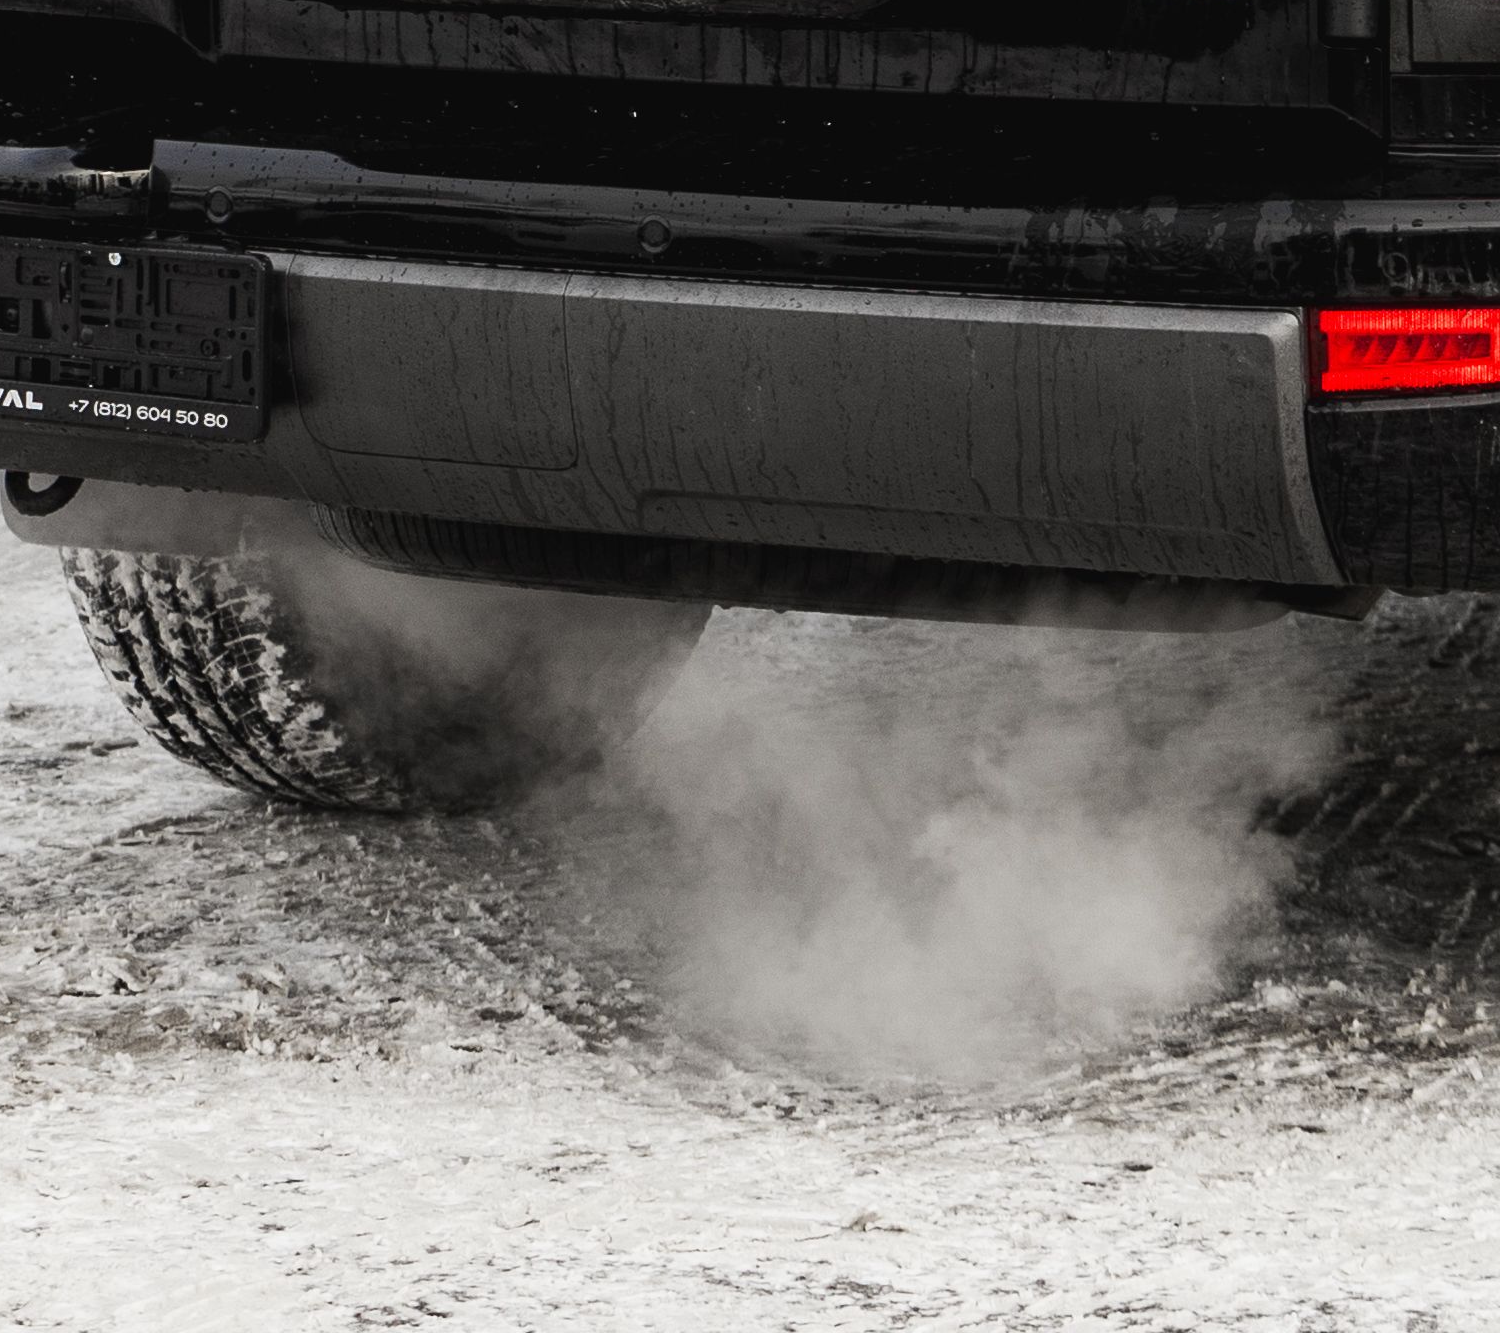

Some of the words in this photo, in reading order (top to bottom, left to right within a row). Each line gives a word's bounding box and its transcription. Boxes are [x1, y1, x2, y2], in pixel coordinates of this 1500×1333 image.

[68, 399, 90, 413] +7
[93, 400, 132, 420] (812)
[136, 405, 171, 423] 604
[175, 410, 199, 426] 50
[203, 412, 229, 429] 80
